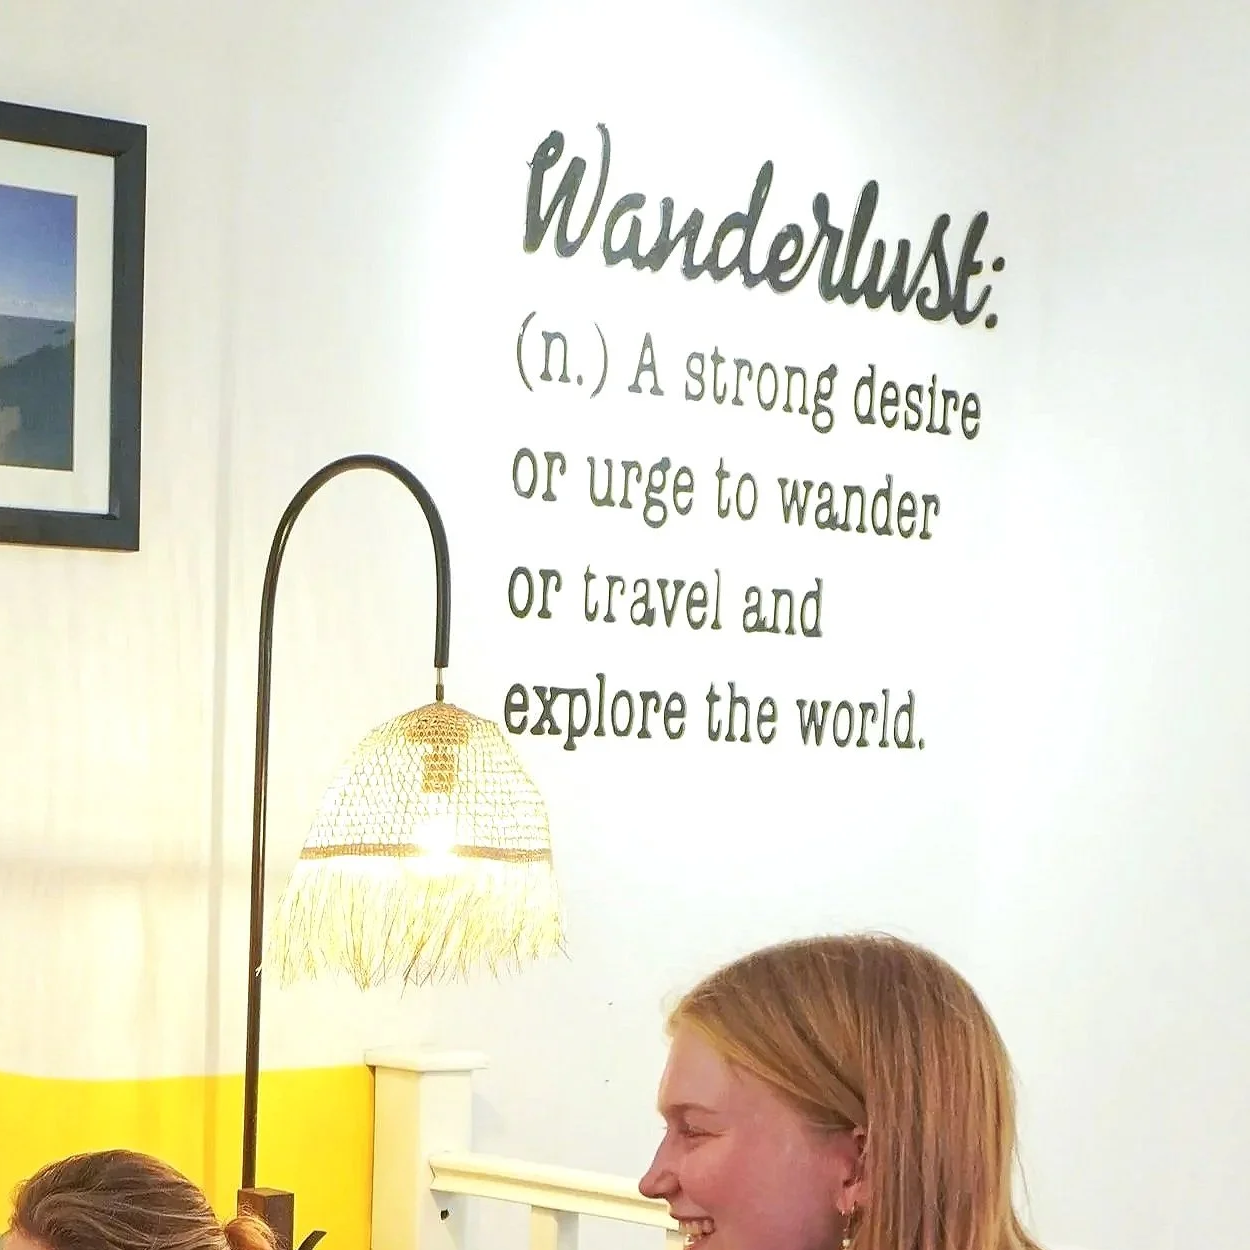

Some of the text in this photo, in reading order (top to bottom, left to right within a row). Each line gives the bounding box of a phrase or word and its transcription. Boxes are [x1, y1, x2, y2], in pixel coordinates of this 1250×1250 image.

[523, 122, 1006, 329] Wanderlust:
[515, 310, 982, 440] (n.) A strong desire
[511, 446, 941, 540] or urge to wander
[507, 565, 823, 638] or travel and
[503, 672, 925, 751] explore the world.
